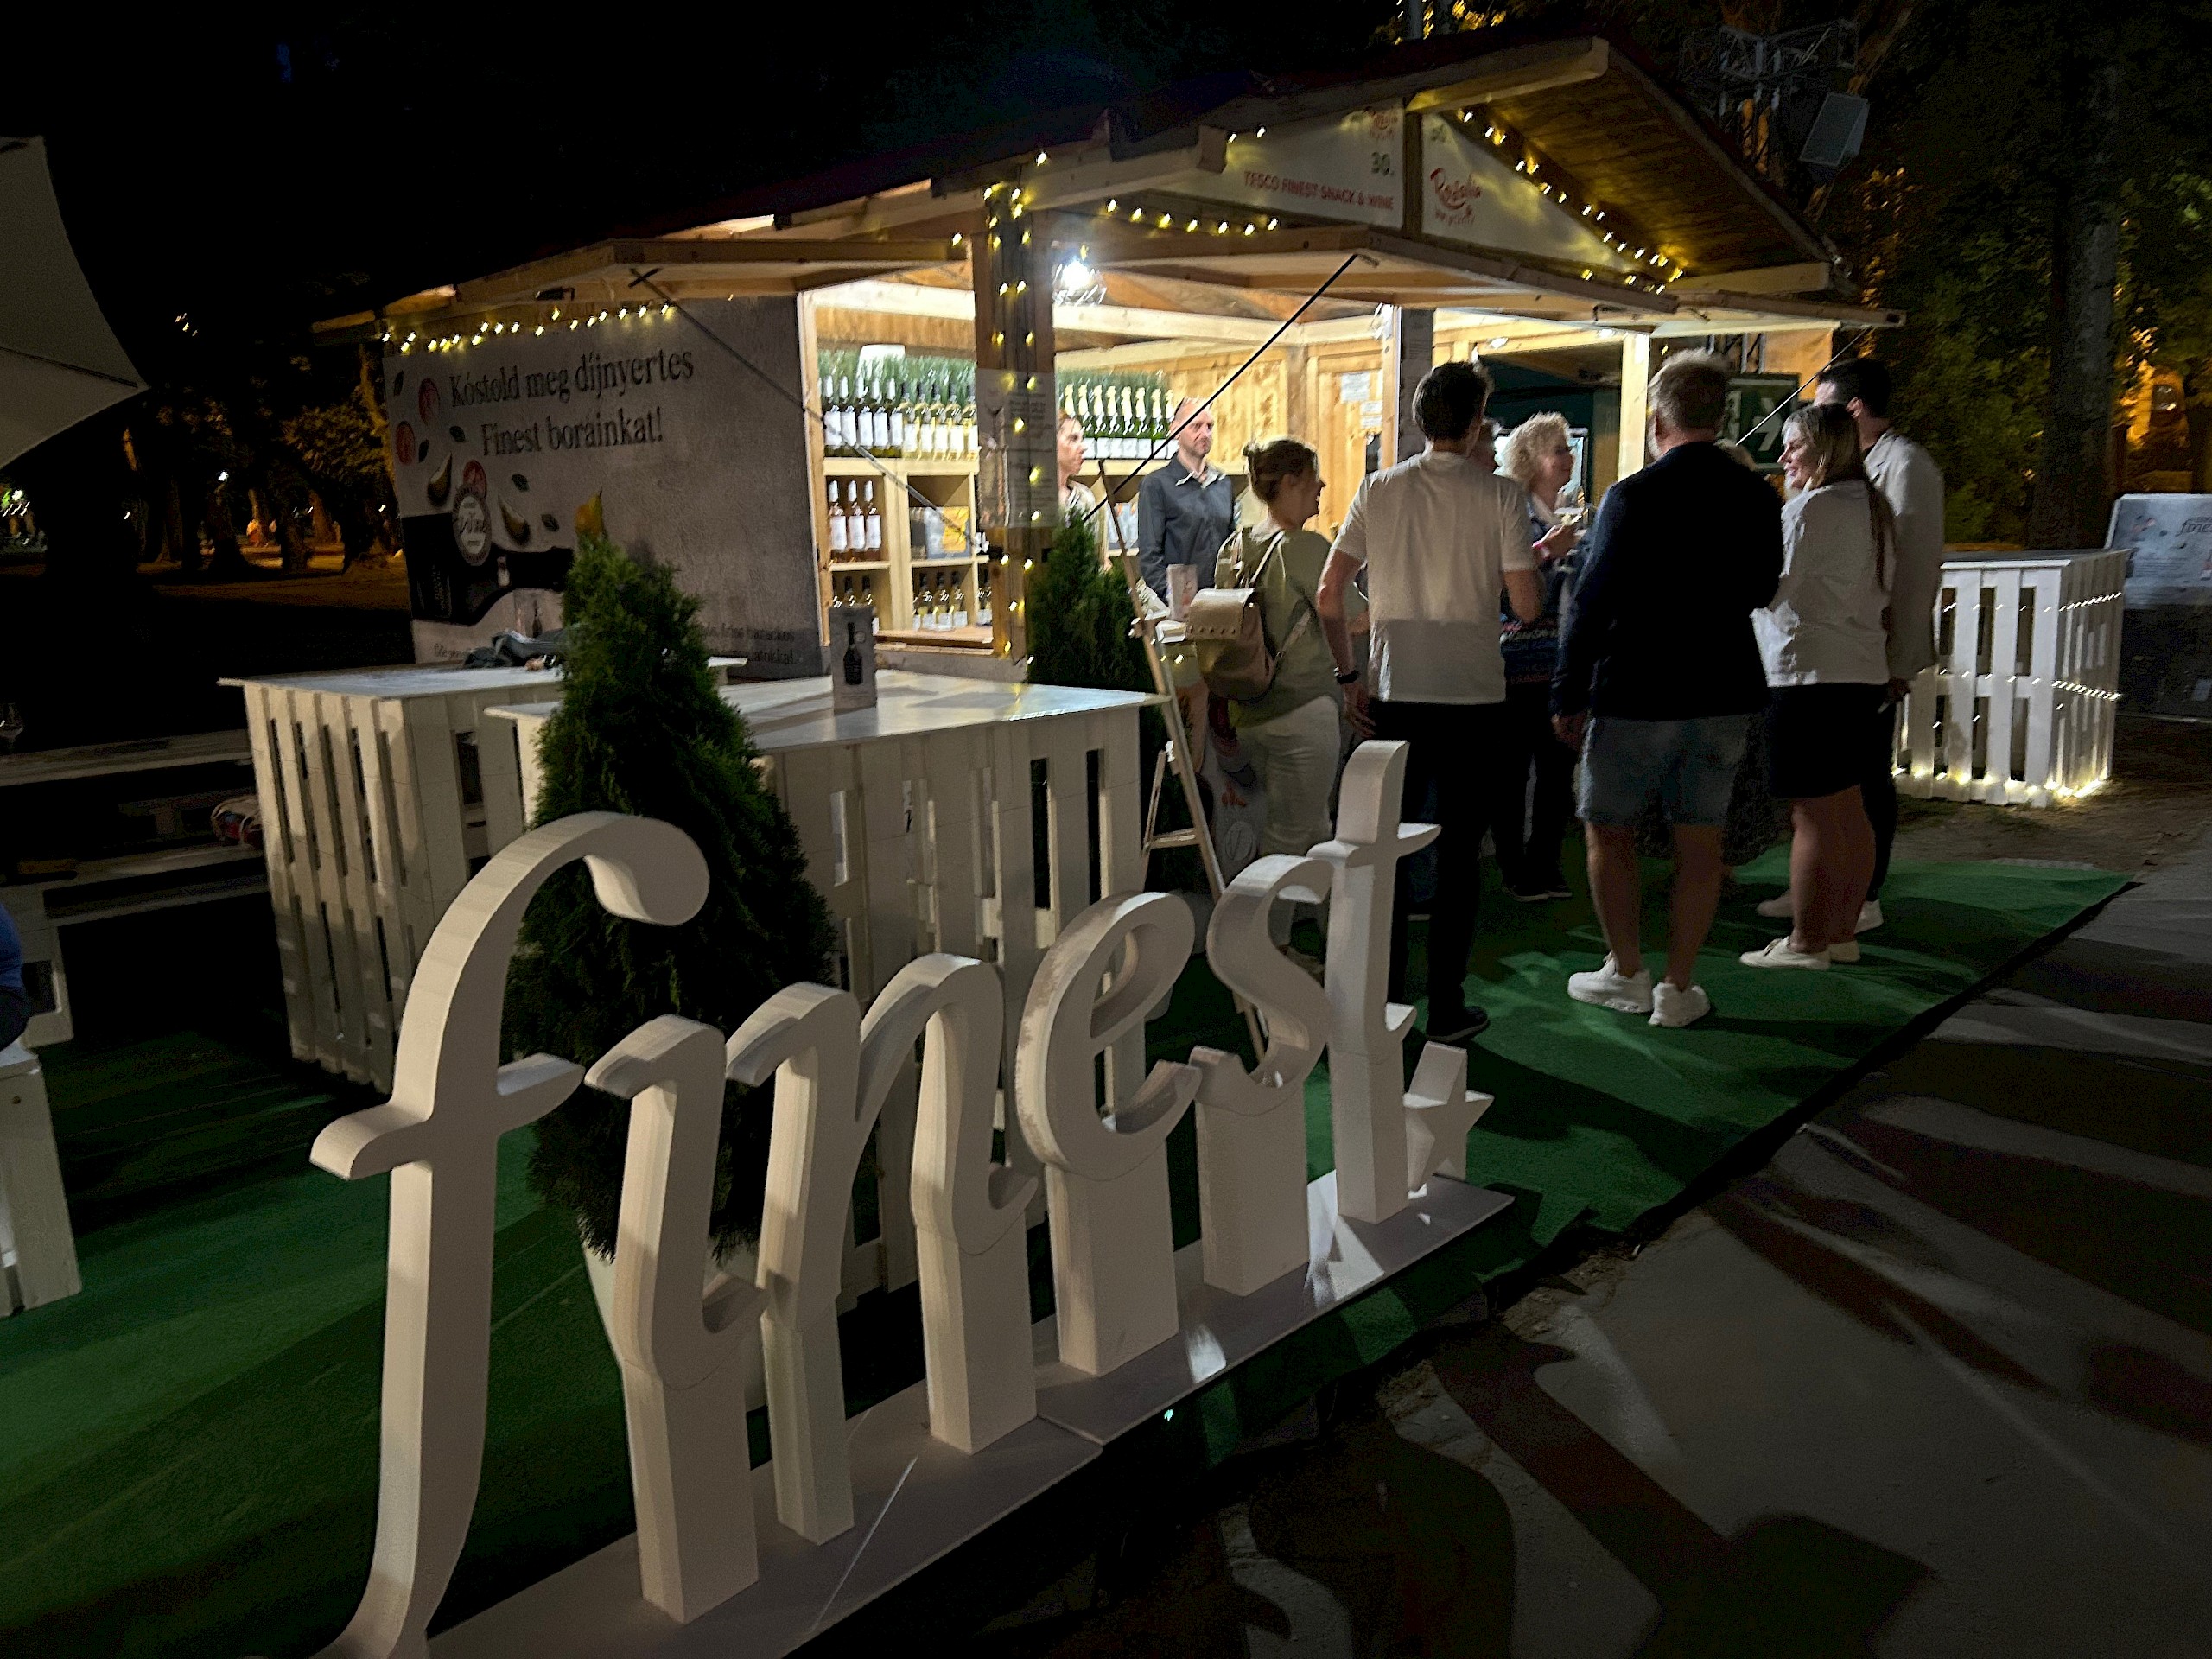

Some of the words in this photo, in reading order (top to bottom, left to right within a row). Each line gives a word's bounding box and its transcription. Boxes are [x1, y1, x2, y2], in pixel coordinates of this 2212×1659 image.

[1244, 171, 1280, 192] TESCO
[1281, 178, 1319, 199] FINEST
[1321, 185, 1355, 204] SNACK
[1357, 192, 1364, 207] &
[1368, 194, 1394, 211] WINE
[449, 365, 520, 407] Kóstold
[525, 366, 570, 404] meg
[575, 348, 694, 400] díjnyertes
[481, 422, 542, 456] Finest
[545, 405, 663, 451] borainkat!
[309, 739, 1443, 1659] finest
